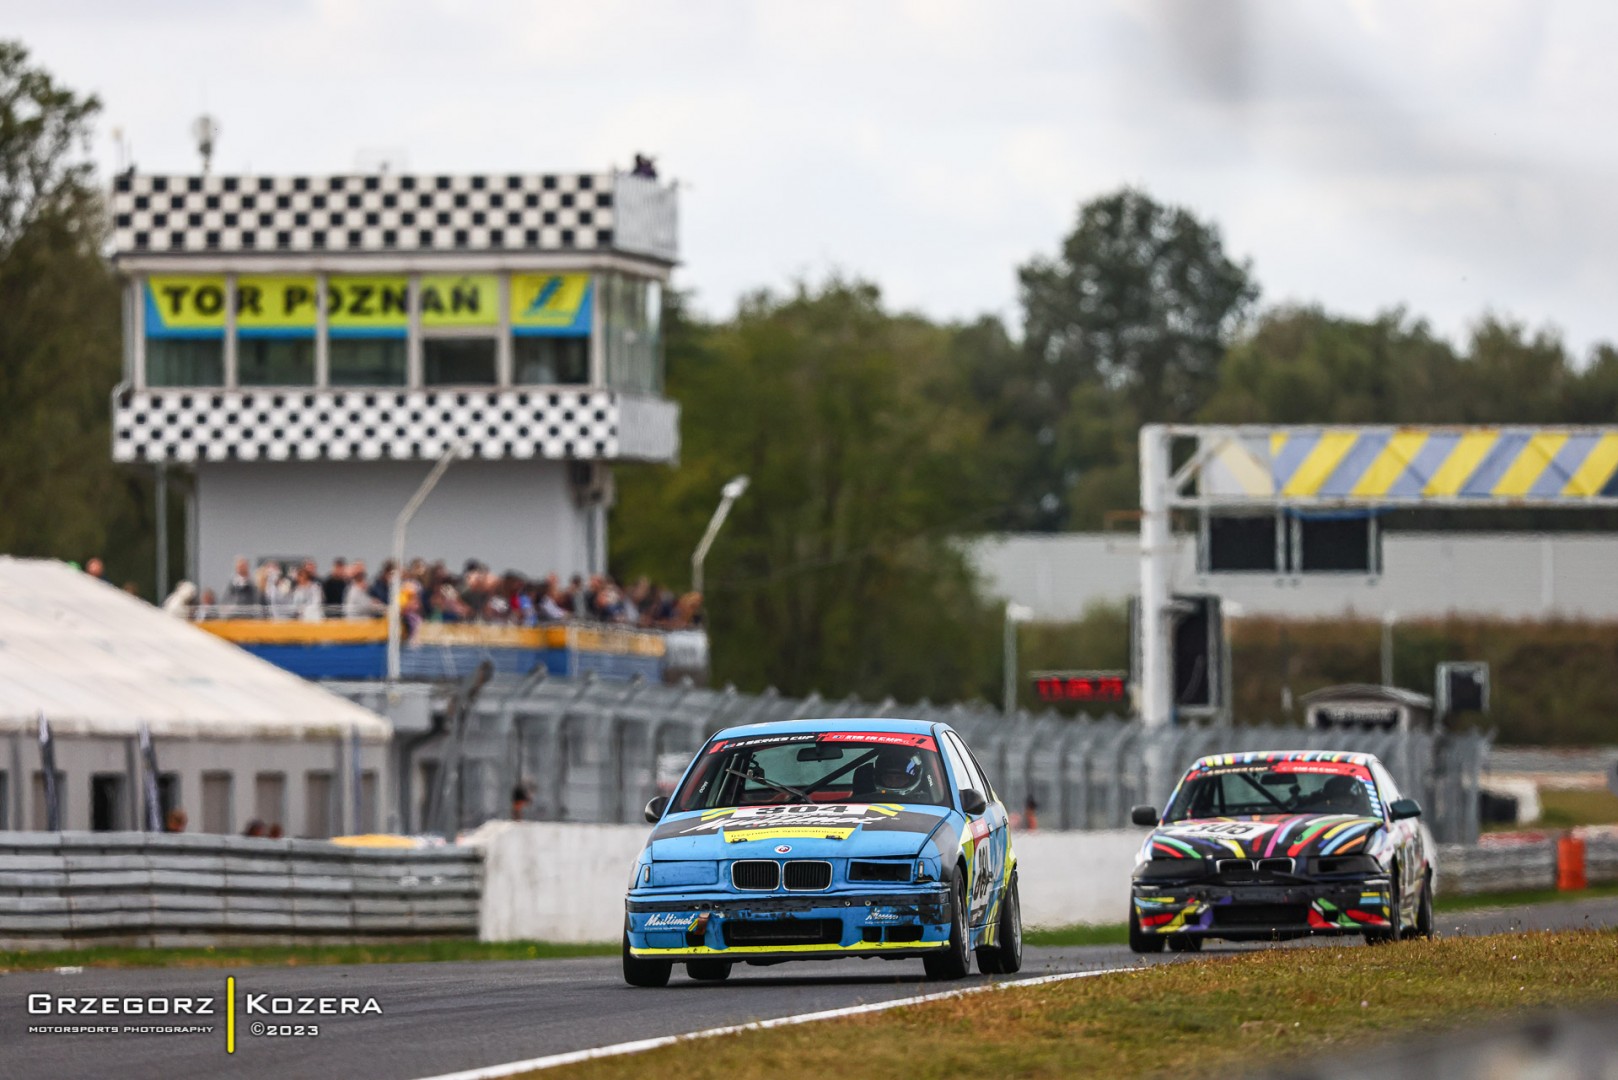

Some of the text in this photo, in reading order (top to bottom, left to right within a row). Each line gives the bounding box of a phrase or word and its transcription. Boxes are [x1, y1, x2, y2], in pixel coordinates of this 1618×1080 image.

[163, 276, 479, 316] TOR POZNAŃ
[756, 804, 850, 814] 304
[644, 913, 696, 927] Multimet
